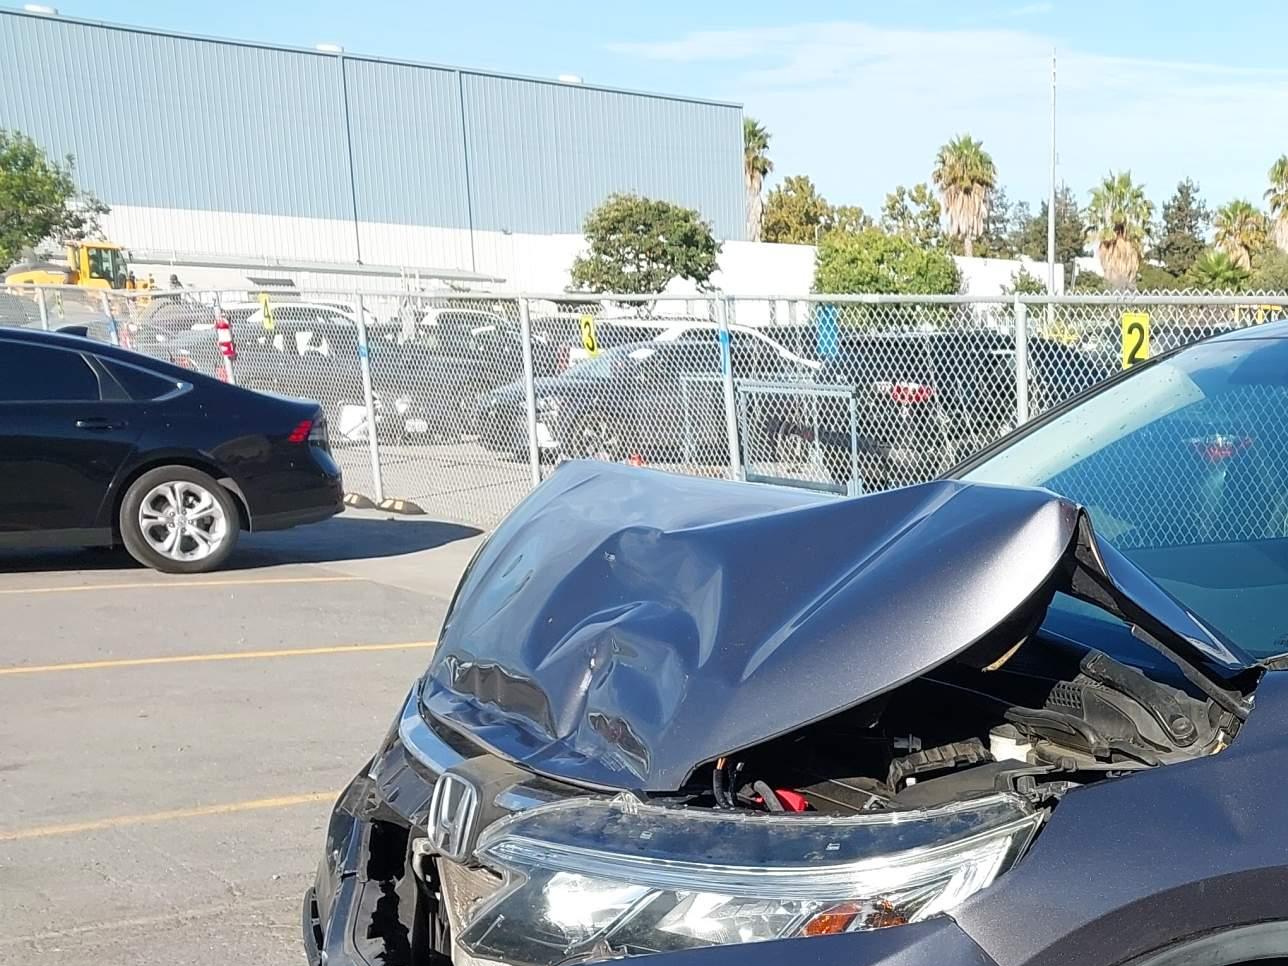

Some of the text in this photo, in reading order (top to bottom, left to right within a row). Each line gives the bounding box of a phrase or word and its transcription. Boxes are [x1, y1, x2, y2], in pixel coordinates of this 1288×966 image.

[263, 298, 272, 325] 4
[584, 321, 595, 352] 3
[1127, 322, 1146, 365] 2
